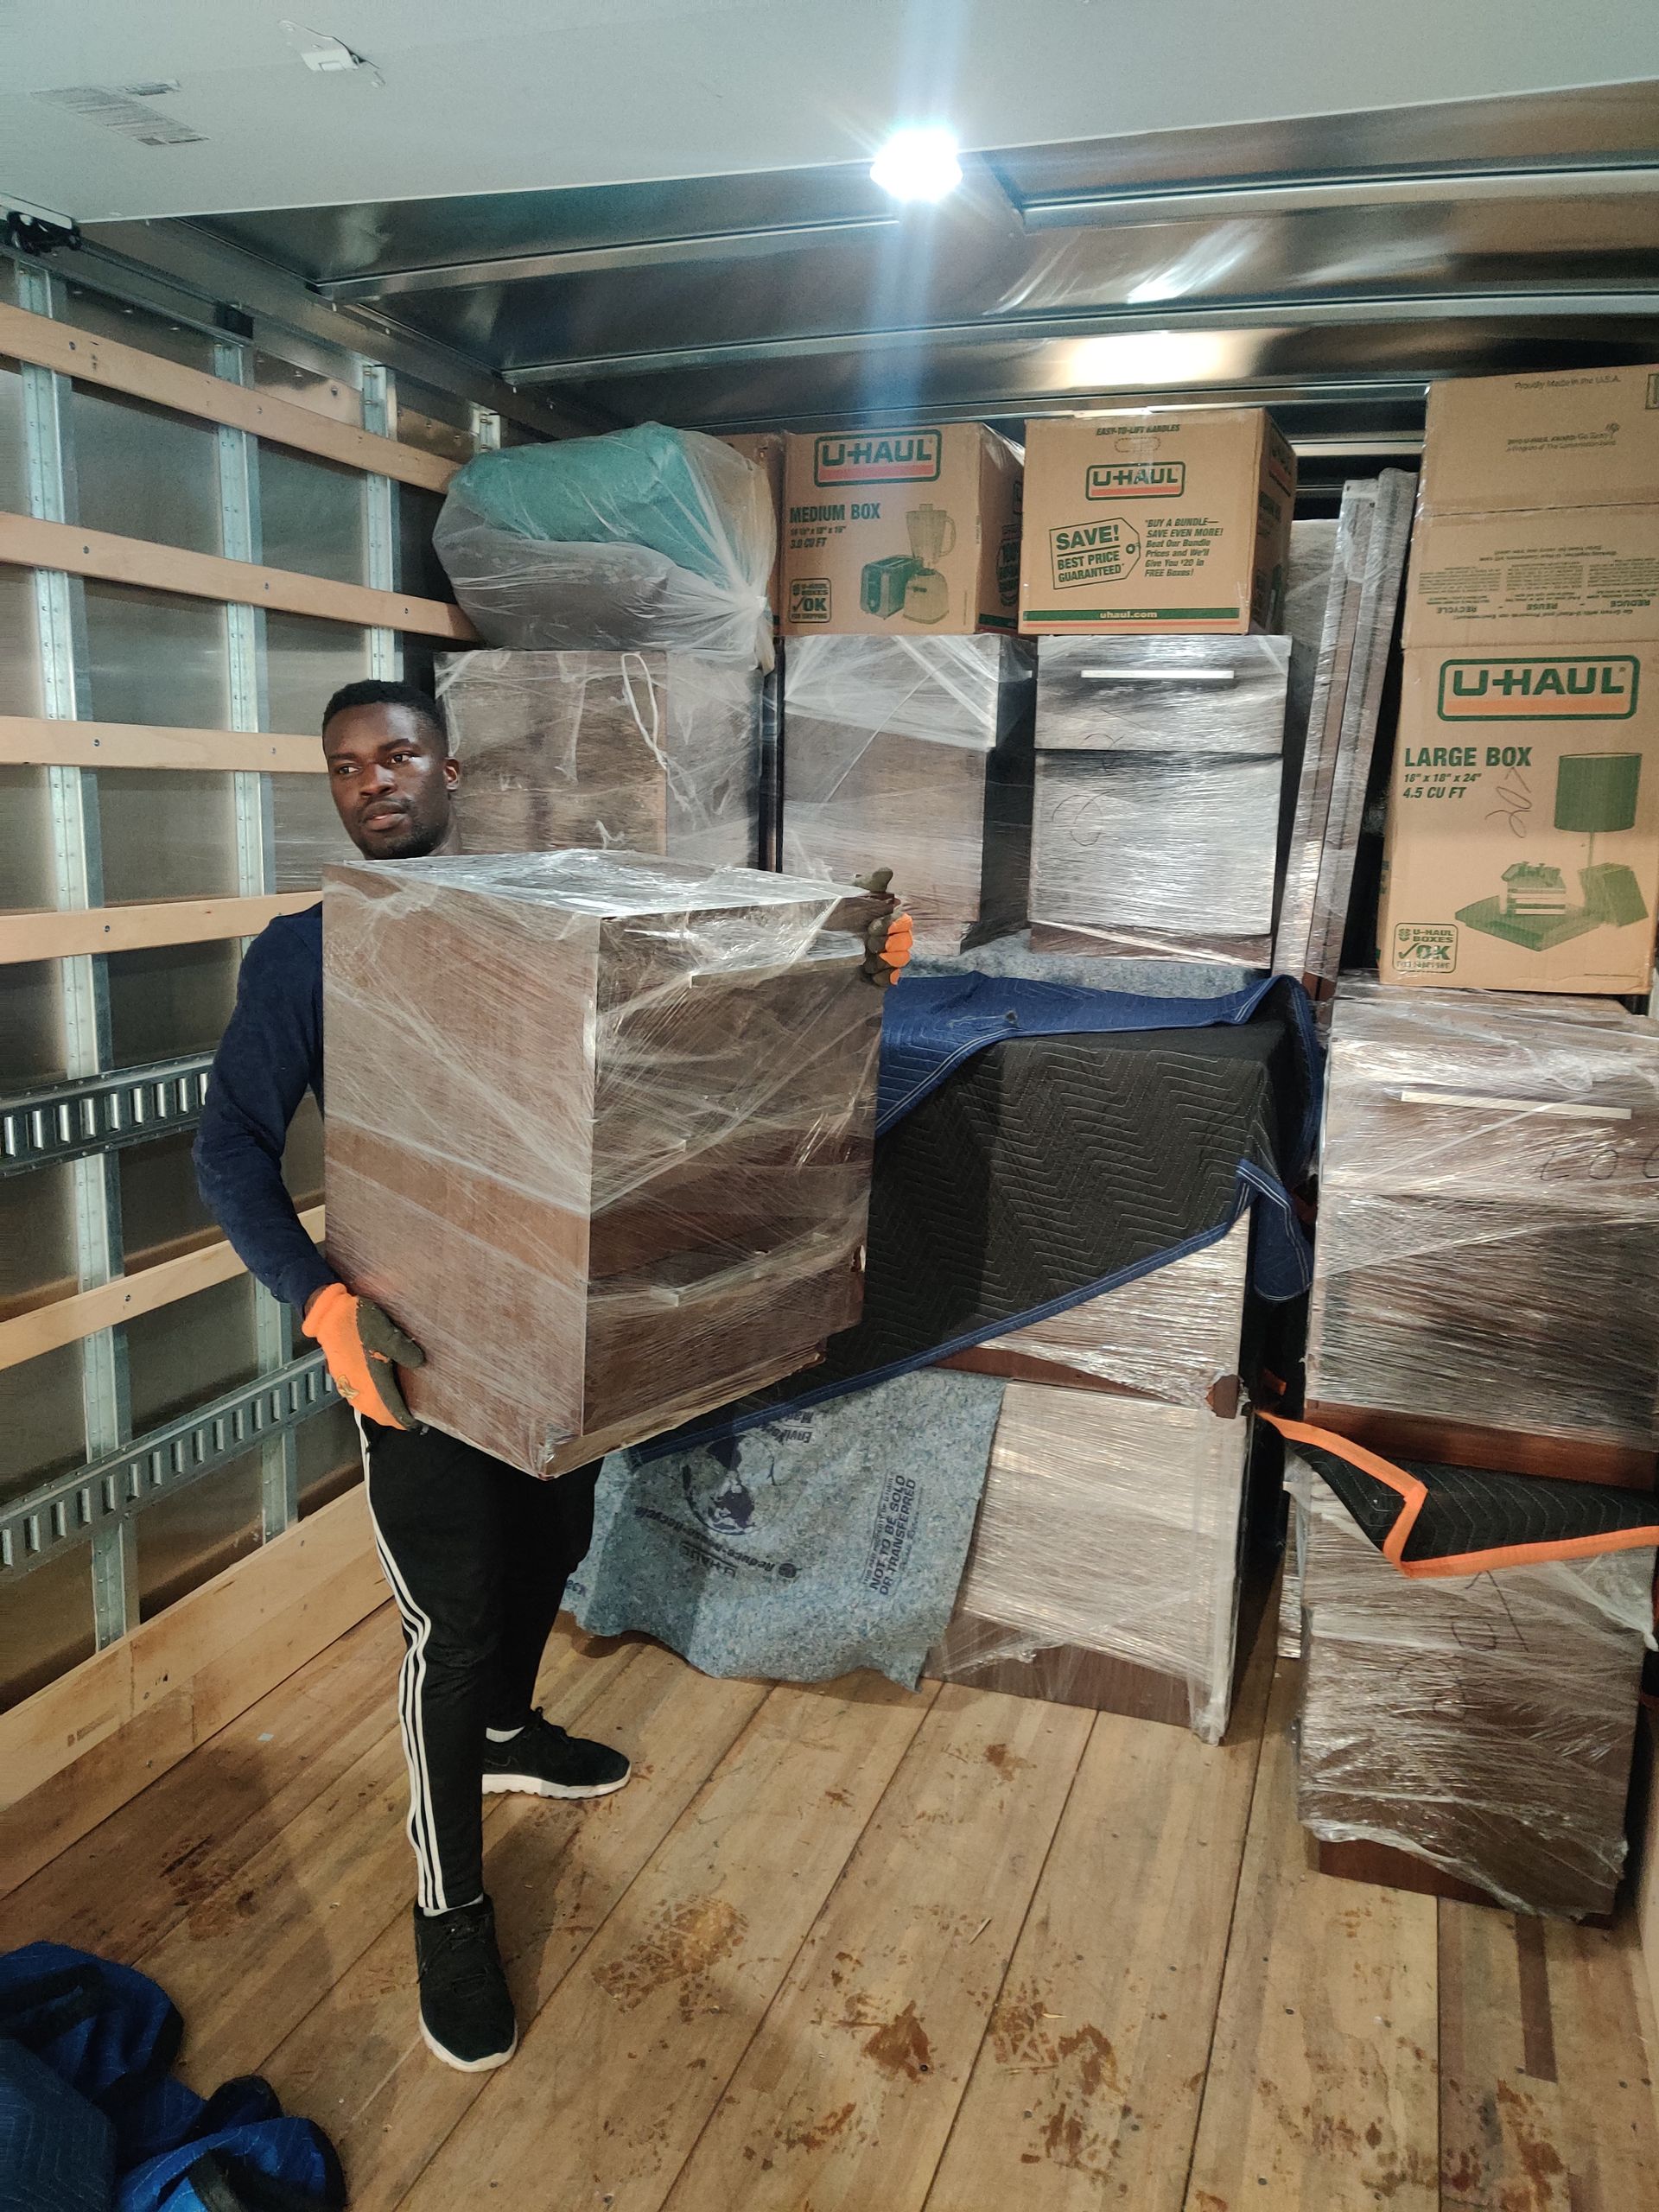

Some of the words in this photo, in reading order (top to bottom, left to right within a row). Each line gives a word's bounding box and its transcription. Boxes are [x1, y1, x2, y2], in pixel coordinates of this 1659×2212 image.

[823, 438, 932, 467] U-HAUL
[1091, 467, 1179, 486] U-HAUL
[790, 505, 845, 524] MEDIUM
[851, 503, 881, 520] BOX
[1056, 524, 1120, 551] SAVE!
[1147, 529, 1170, 537] SAVE
[1170, 528, 1192, 537] EVEN
[1194, 527, 1224, 537] MORE!
[1146, 539, 1164, 548] Beat
[1183, 538, 1211, 547] Bundle
[1058, 556, 1084, 570] BEST
[1088, 550, 1120, 566] PRICE
[1165, 558, 1179, 567] You
[1145, 569, 1166, 577] FREE
[1166, 568, 1194, 576] Boxes!
[804, 598, 827, 612] OK
[1437, 606, 1478, 614] RECYCLE
[1099, 609, 1158, 620] uhaul.com
[1452, 666, 1624, 696] U-HAUL
[1404, 747, 1477, 767] LARGE
[1486, 747, 1533, 767] BOX
[1463, 772, 1482, 782] 24"
[1403, 786, 1423, 798] 4.5
[1427, 786, 1446, 798] CU
[1448, 786, 1466, 798] FT
[1416, 944, 1451, 960] OK
[890, 1474, 905, 1512] SOLD
[884, 1516, 897, 1535] BE
[879, 1575, 893, 1596] OR
[887, 1478, 917, 1573] TRANSFERRED
[880, 1538, 891, 1556] TO
[869, 1558, 886, 1591] NOT
